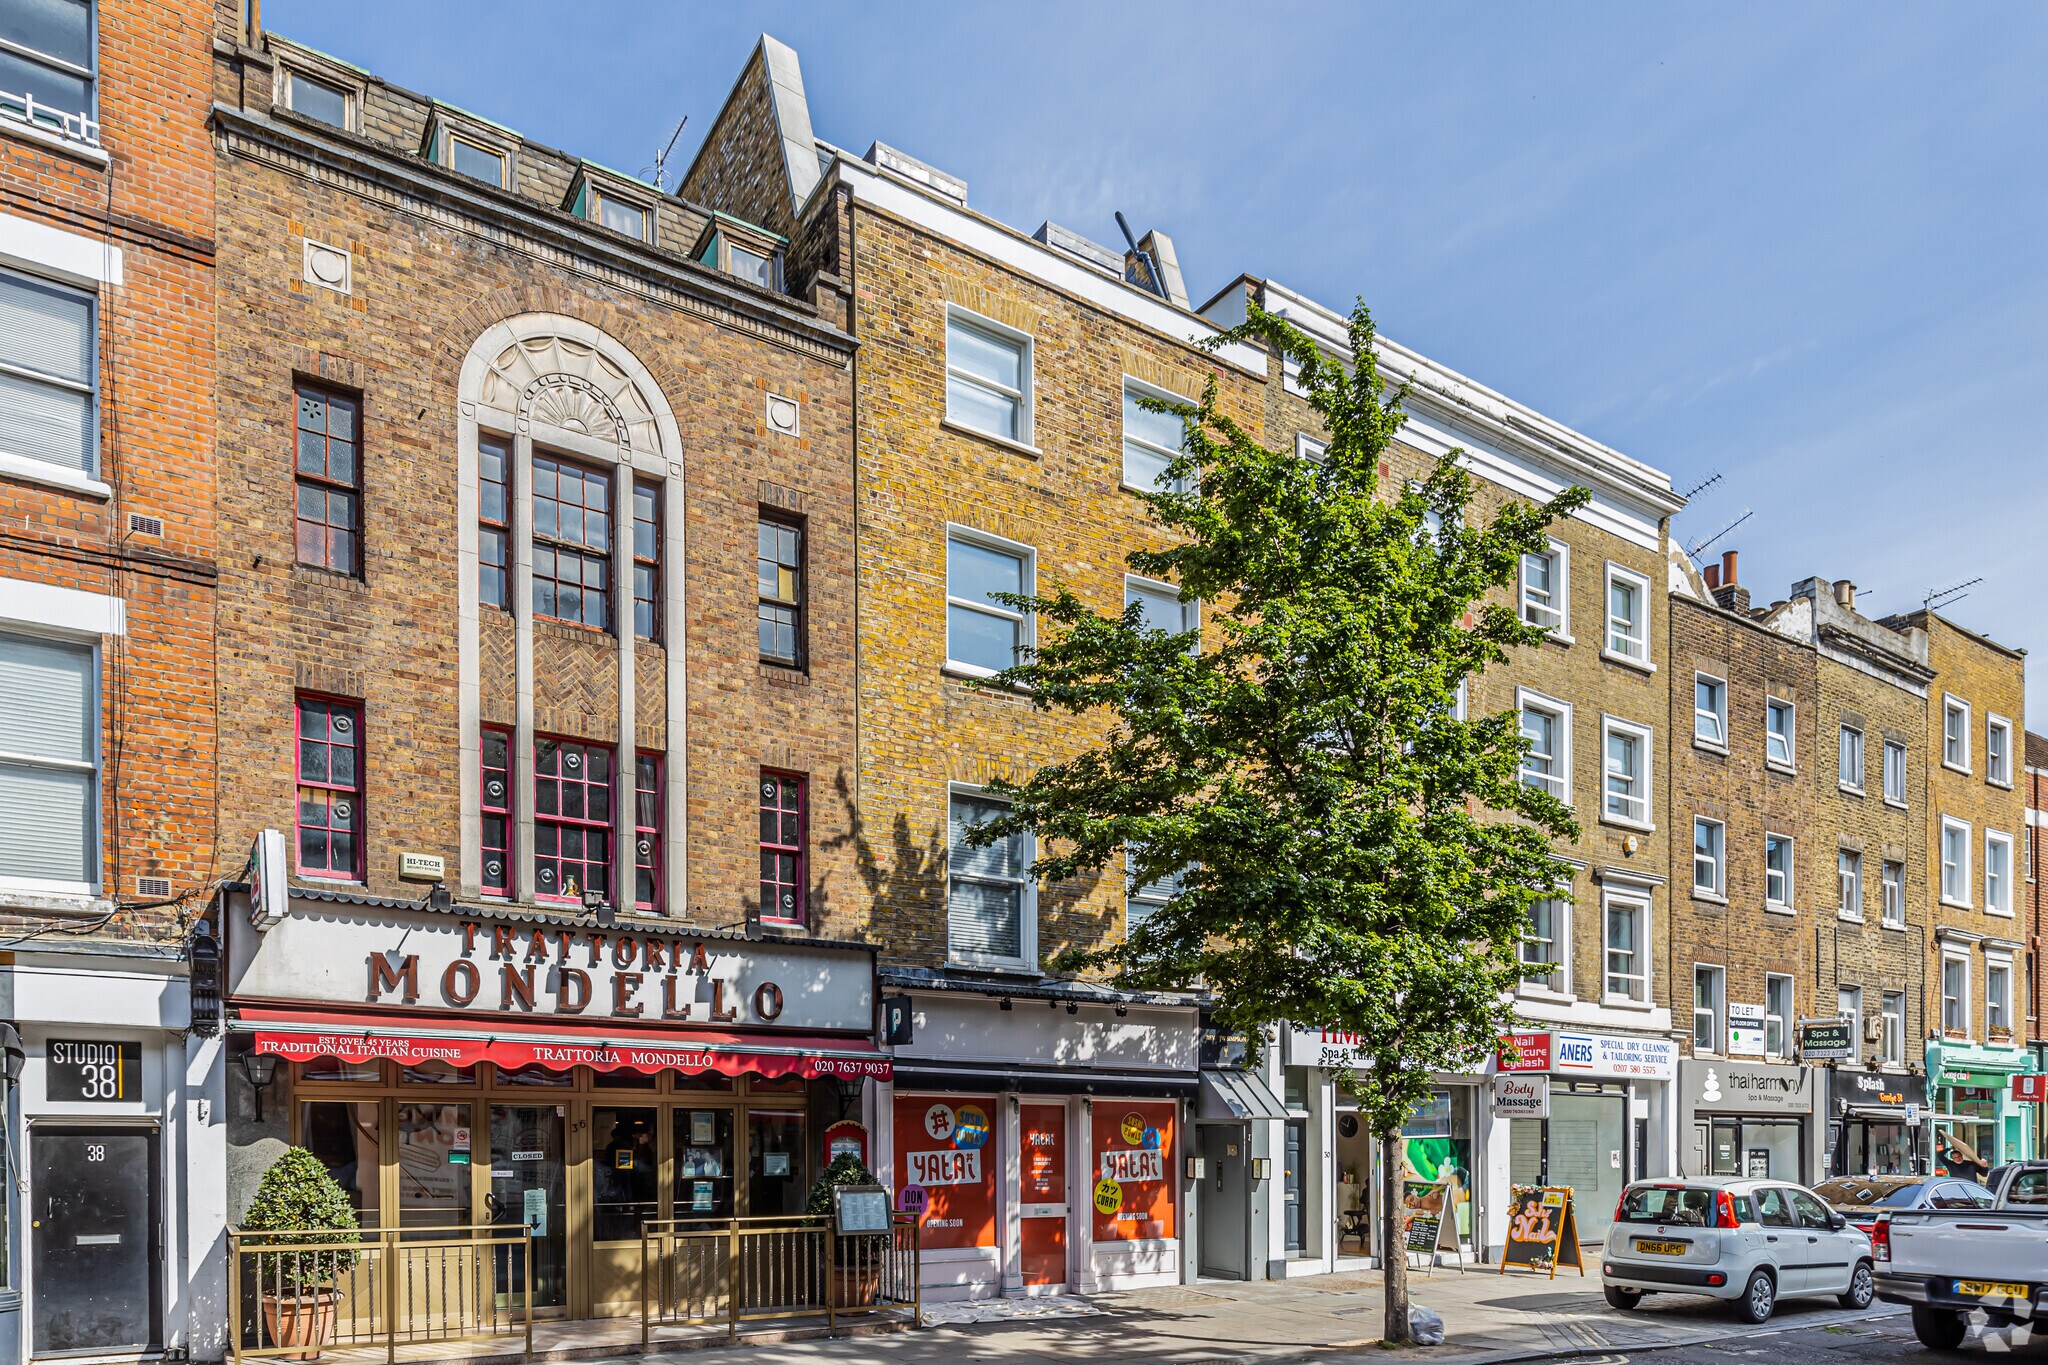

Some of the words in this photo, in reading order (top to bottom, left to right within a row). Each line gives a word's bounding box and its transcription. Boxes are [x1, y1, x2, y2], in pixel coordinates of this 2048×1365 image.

[407, 858, 440, 867] HI-TECH
[459, 921, 710, 971] TRATTORIA
[369, 951, 784, 1021] MONDELLO
[1731, 1005, 1740, 1015] TO
[1741, 1007, 1754, 1016] LET
[1811, 1030, 1829, 1038] Spa
[1832, 1029, 1840, 1037] &
[318, 1036, 337, 1045] EST.
[339, 1037, 365, 1046] OVER
[367, 1038, 378, 1046] 45
[379, 1039, 410, 1048] YEARS
[1514, 1036, 1534, 1046] Nail
[1600, 1040, 1624, 1050] SPECIAL
[1627, 1042, 1640, 1051] DRY
[1642, 1043, 1670, 1053] CLEANING
[1804, 1039, 1846, 1047] Massage
[53, 1043, 115, 1065] STUDIO
[261, 1041, 354, 1056] TRADITIONAL
[356, 1045, 409, 1057] ITALIAN
[411, 1047, 461, 1058] CUISINE
[1321, 1047, 1339, 1060] Spa
[533, 1047, 621, 1063] TRATTORIA
[631, 1052, 713, 1067] MONDELLO
[1602, 1051, 1607, 1060] &
[1611, 1052, 1642, 1062] TAILORING
[1644, 1054, 1667, 1064] SERVICE
[814, 1060, 834, 1072] 020
[836, 1061, 862, 1073] 7637
[864, 1062, 890, 1074] 9037
[81, 1065, 116, 1098] 38
[1857, 1076, 1885, 1091] Splash
[1504, 1081, 1534, 1098] Body
[1496, 1097, 1541, 1109] Massage
[1763, 1094, 1783, 1103] Massage
[959, 1110, 984, 1127] SUSHI
[1127, 1116, 1143, 1129] SUSHI
[955, 1128, 982, 1146] BOWLS
[1123, 1127, 1142, 1141] BOWLS
[87, 1145, 105, 1162] 38
[513, 1152, 543, 1160] CLOSED
[1101, 1183, 1118, 1195] カツ
[905, 1190, 922, 1204] DON
[1096, 1194, 1118, 1209] CURRY
[949, 1219, 963, 1227] SOON
[1511, 1214, 1557, 1244] Nail
[1640, 1242, 1662, 1251] DN66
[1664, 1244, 1682, 1253] UPG
